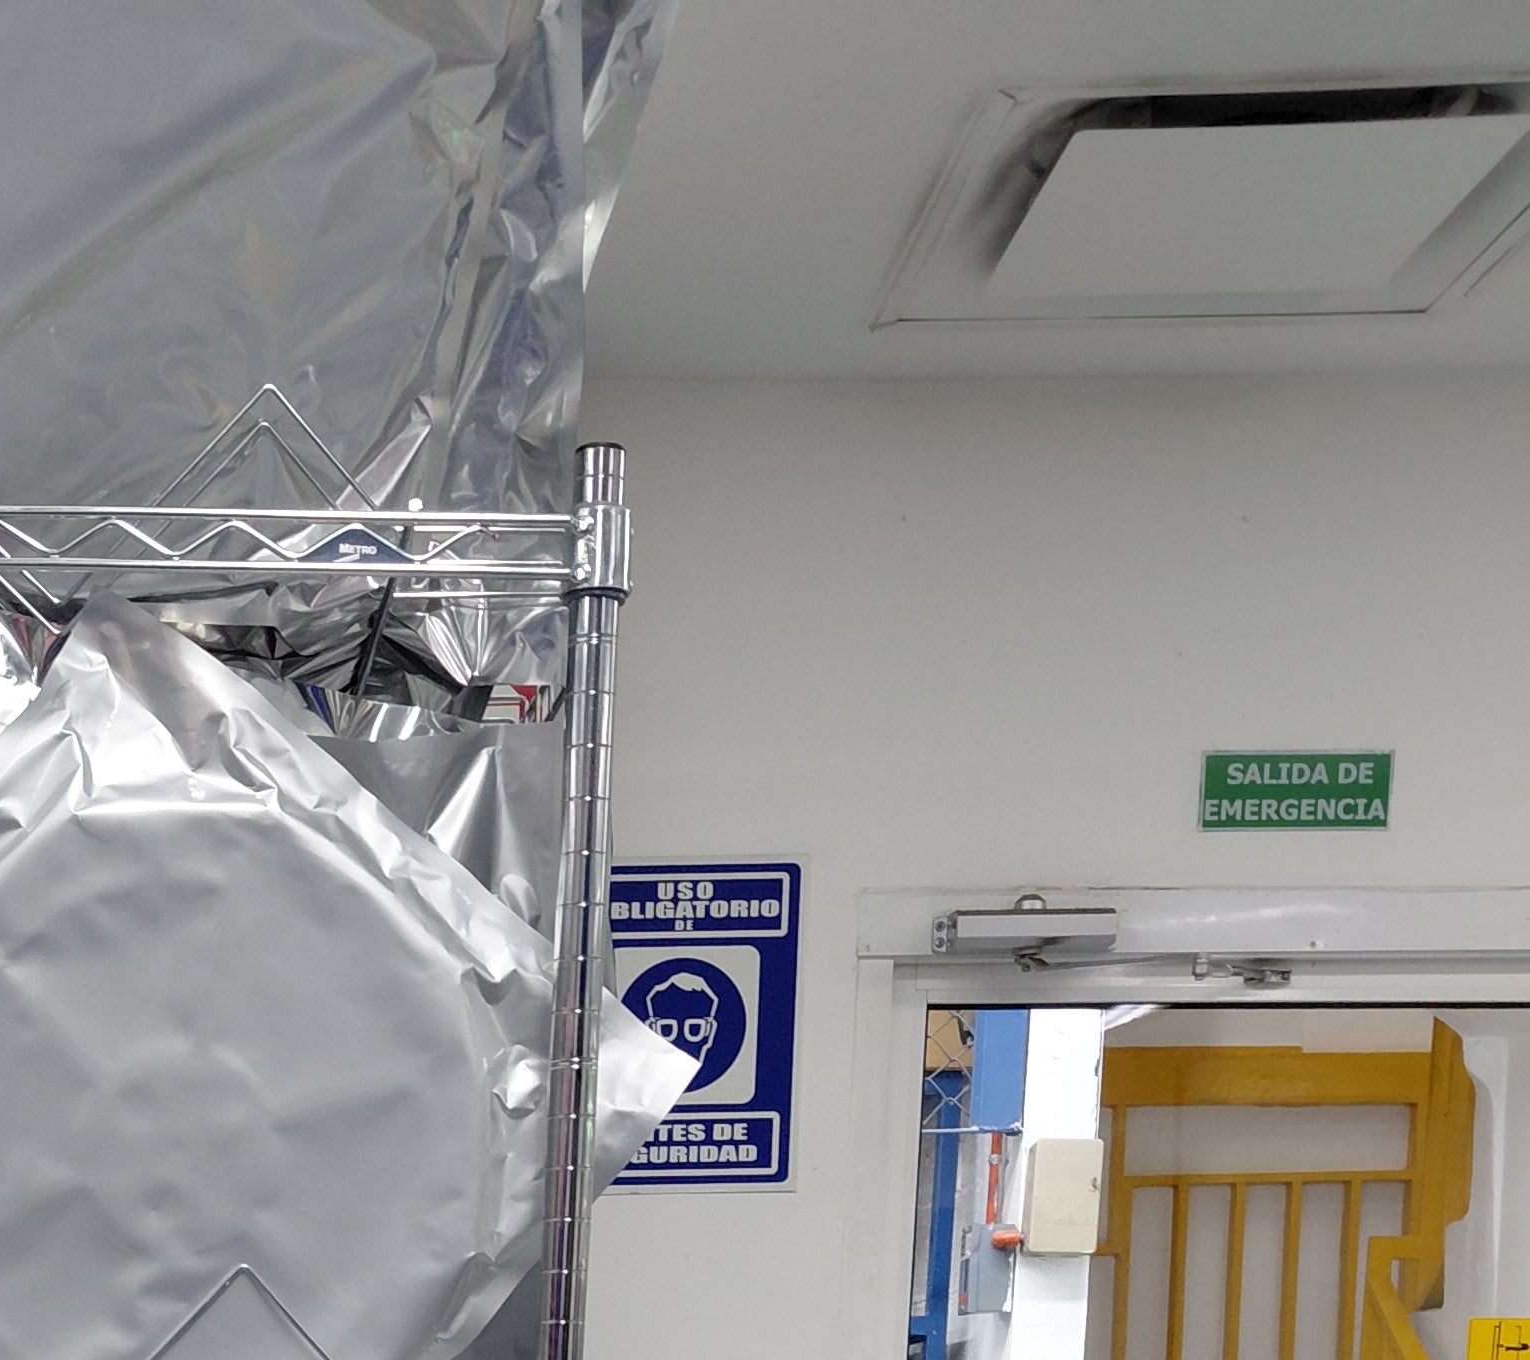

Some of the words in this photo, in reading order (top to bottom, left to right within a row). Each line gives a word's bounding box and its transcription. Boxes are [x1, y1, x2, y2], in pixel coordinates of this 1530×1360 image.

[338, 543, 378, 558] METRO
[1226, 762, 1329, 785] SALIDA
[1338, 762, 1374, 785] DE
[1204, 798, 1385, 821] EMERGENCIA
[657, 881, 714, 900] USO
[611, 898, 780, 919] BLIGATORIO
[675, 920, 694, 931] DE
[713, 1123, 748, 1141] DE
[628, 1144, 758, 1163] GURIDAD
